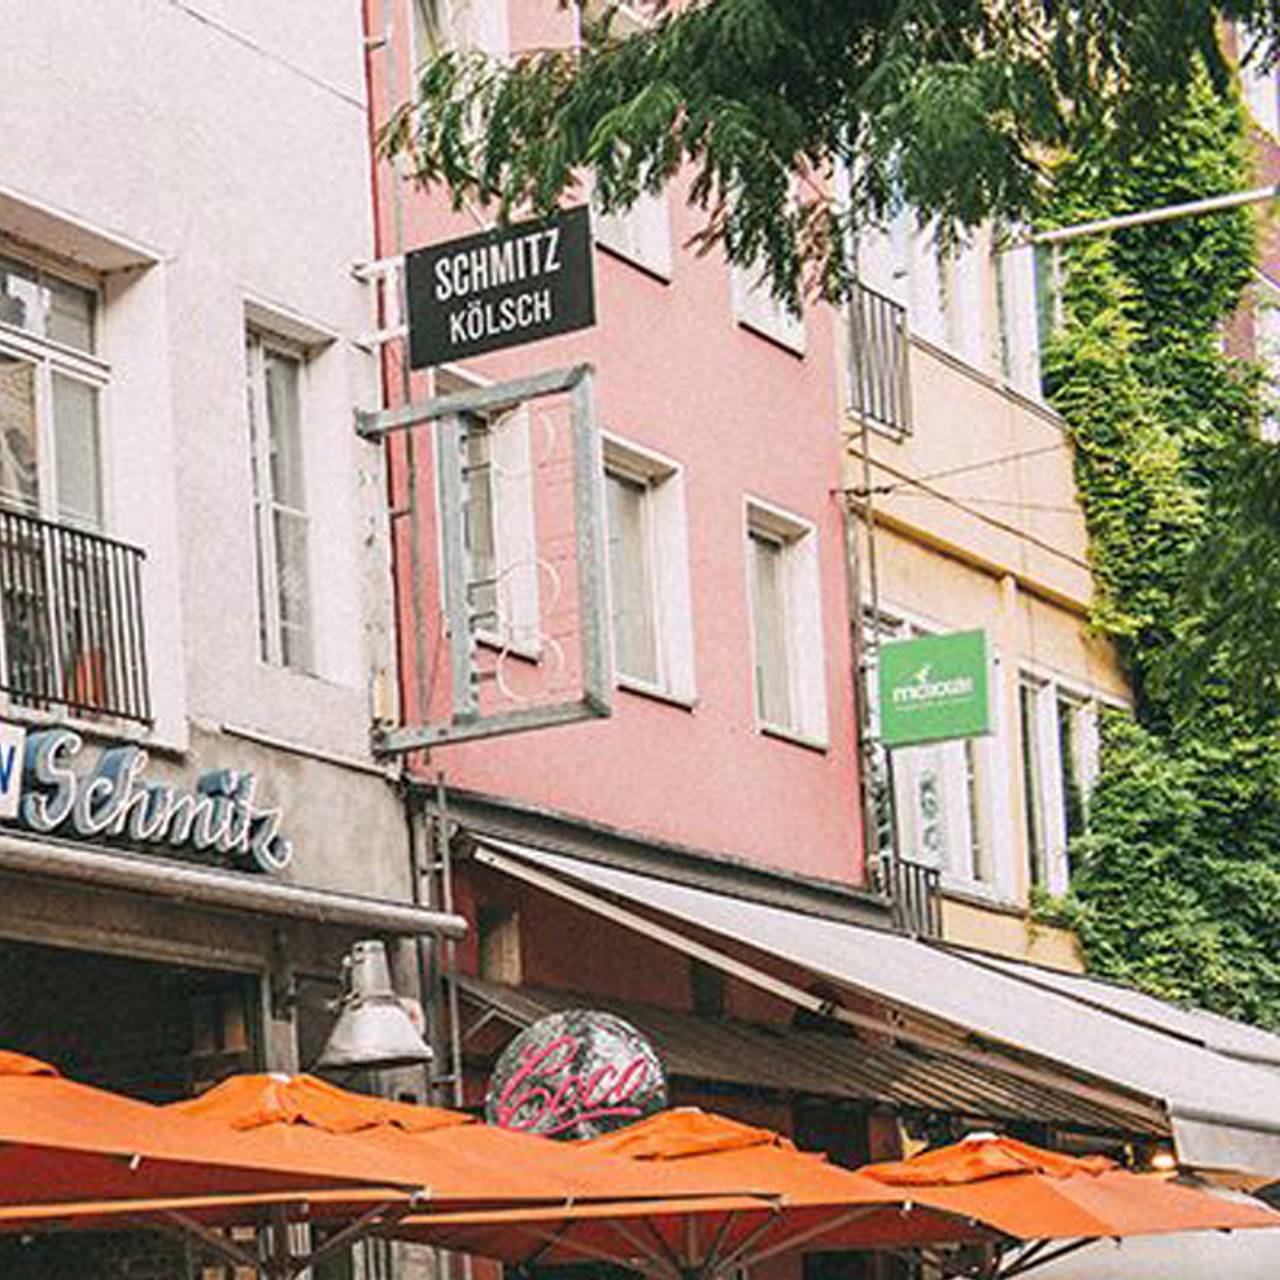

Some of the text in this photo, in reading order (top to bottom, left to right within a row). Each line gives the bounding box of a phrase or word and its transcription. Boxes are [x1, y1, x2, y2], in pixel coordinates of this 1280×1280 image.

[434, 227, 562, 301] SCHMITZ
[449, 289, 552, 344] KÖLSCH
[26, 727, 293, 871] Schmitz
